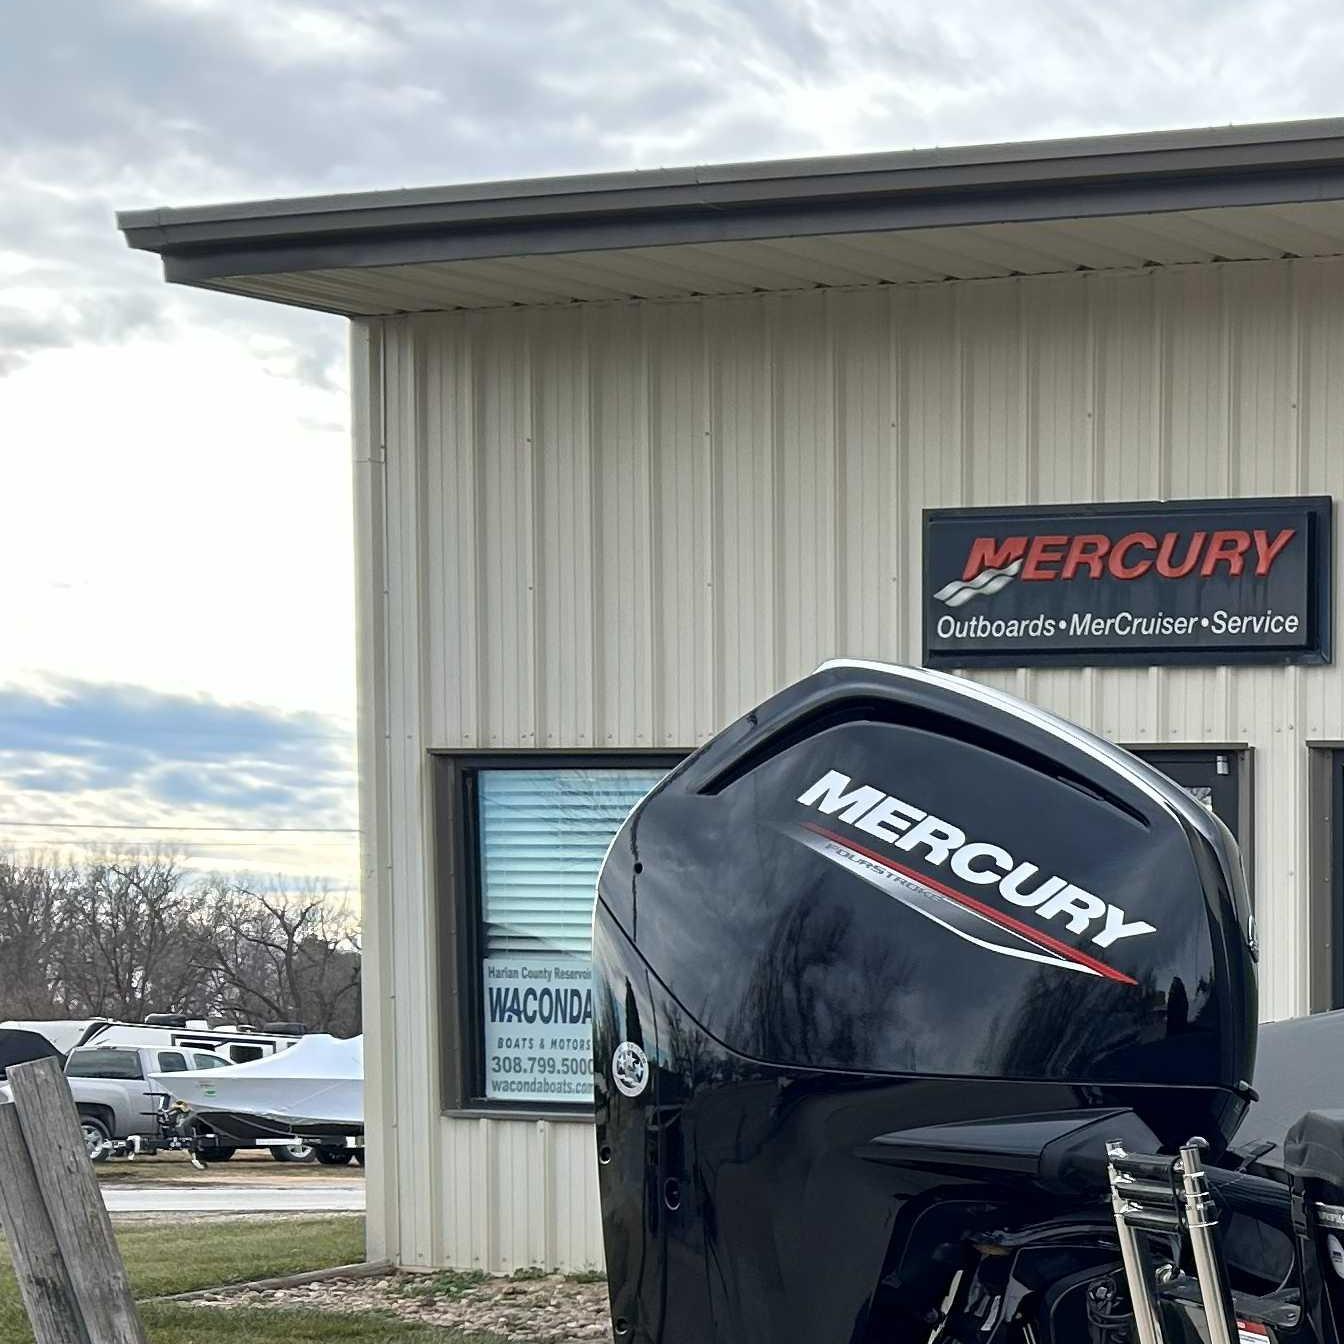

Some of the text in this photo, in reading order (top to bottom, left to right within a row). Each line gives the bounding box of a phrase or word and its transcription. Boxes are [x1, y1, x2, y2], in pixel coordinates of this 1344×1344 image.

[961, 529, 1296, 582] MERCURY
[937, 610, 1299, 639] Outboards MerCruiser Service
[797, 769, 1158, 949] MERCURY
[521, 966, 552, 982] County
[488, 987, 593, 1025] WACONDA
[497, 1036, 591, 1051] BOATS & MOTORS
